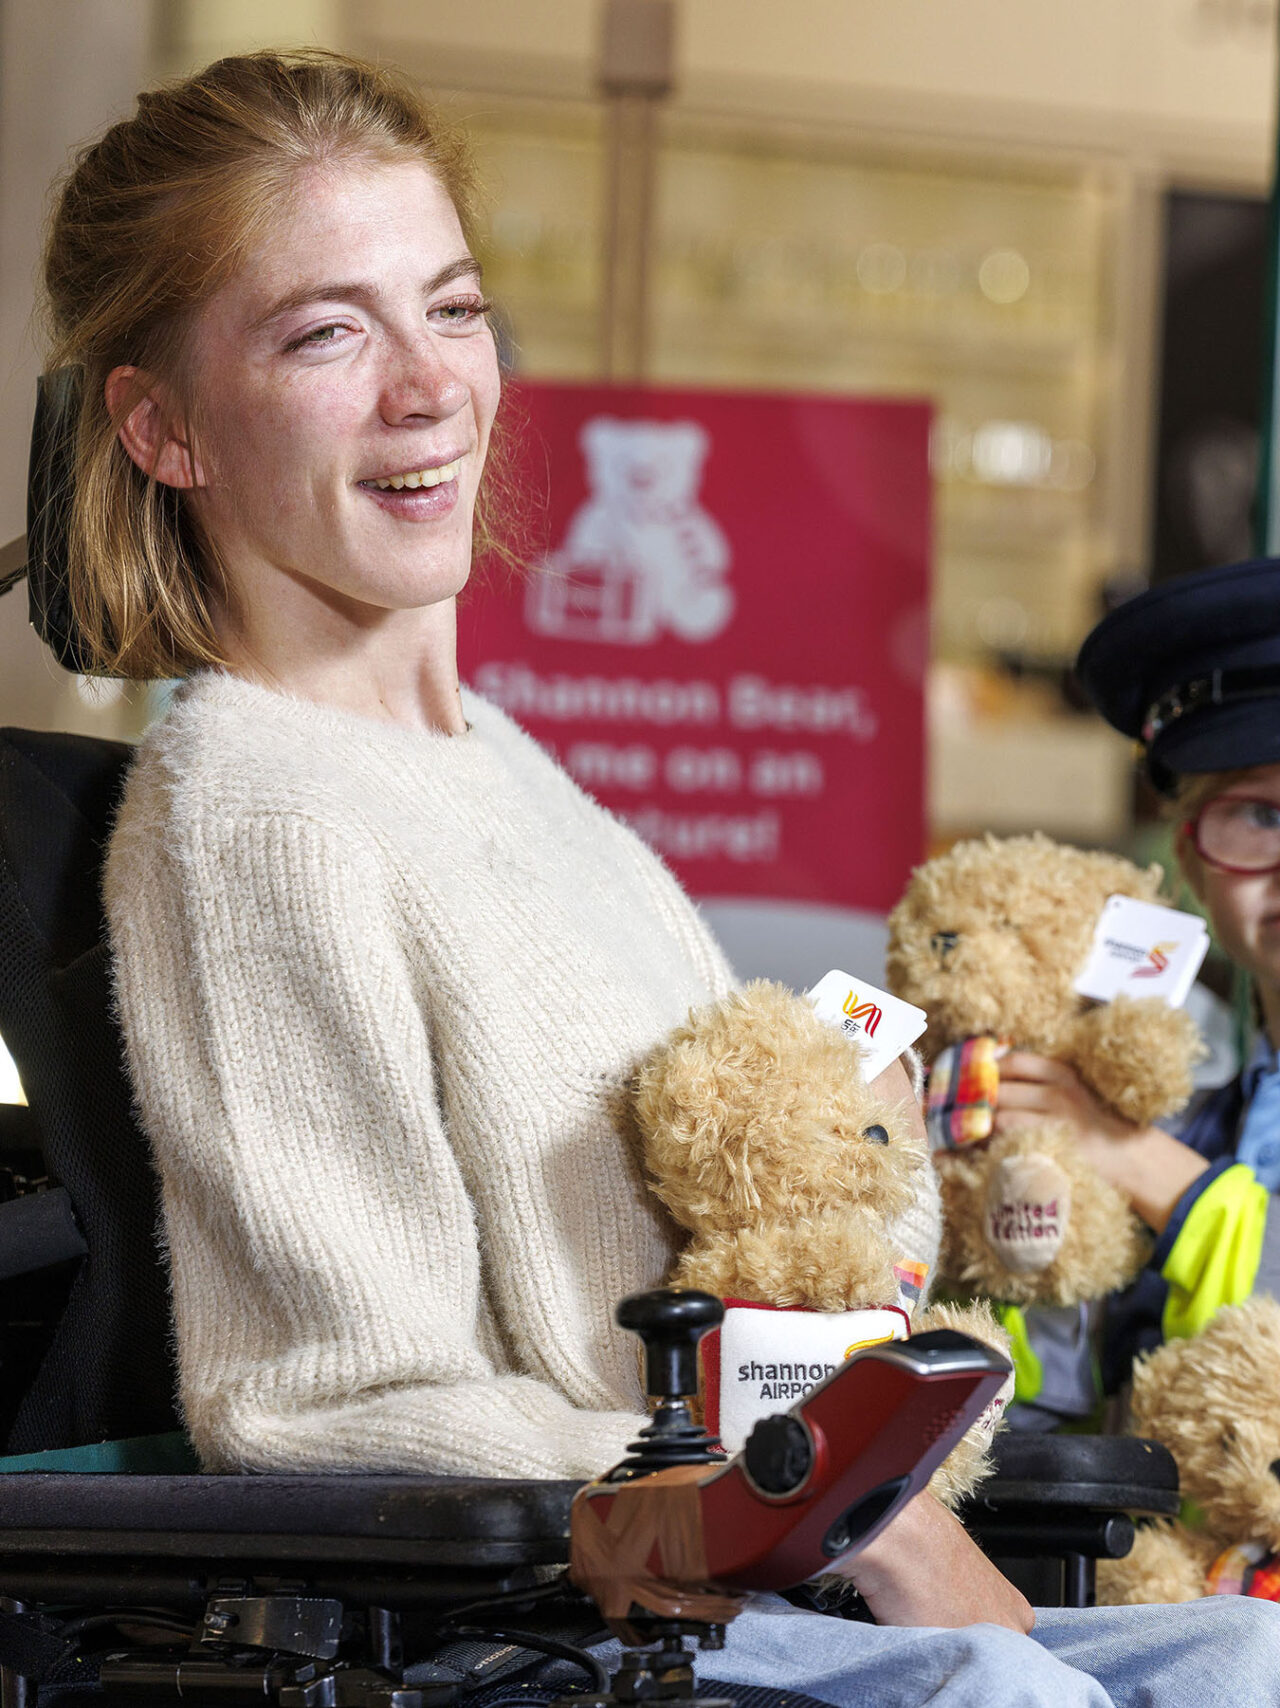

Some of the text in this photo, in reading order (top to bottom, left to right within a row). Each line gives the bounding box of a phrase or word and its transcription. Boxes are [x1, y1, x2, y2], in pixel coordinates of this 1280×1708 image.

[738, 1361, 837, 1382] shannon
[759, 1382, 815, 1400] AIRPO
[474, 1644, 518, 1669] ottoboc
